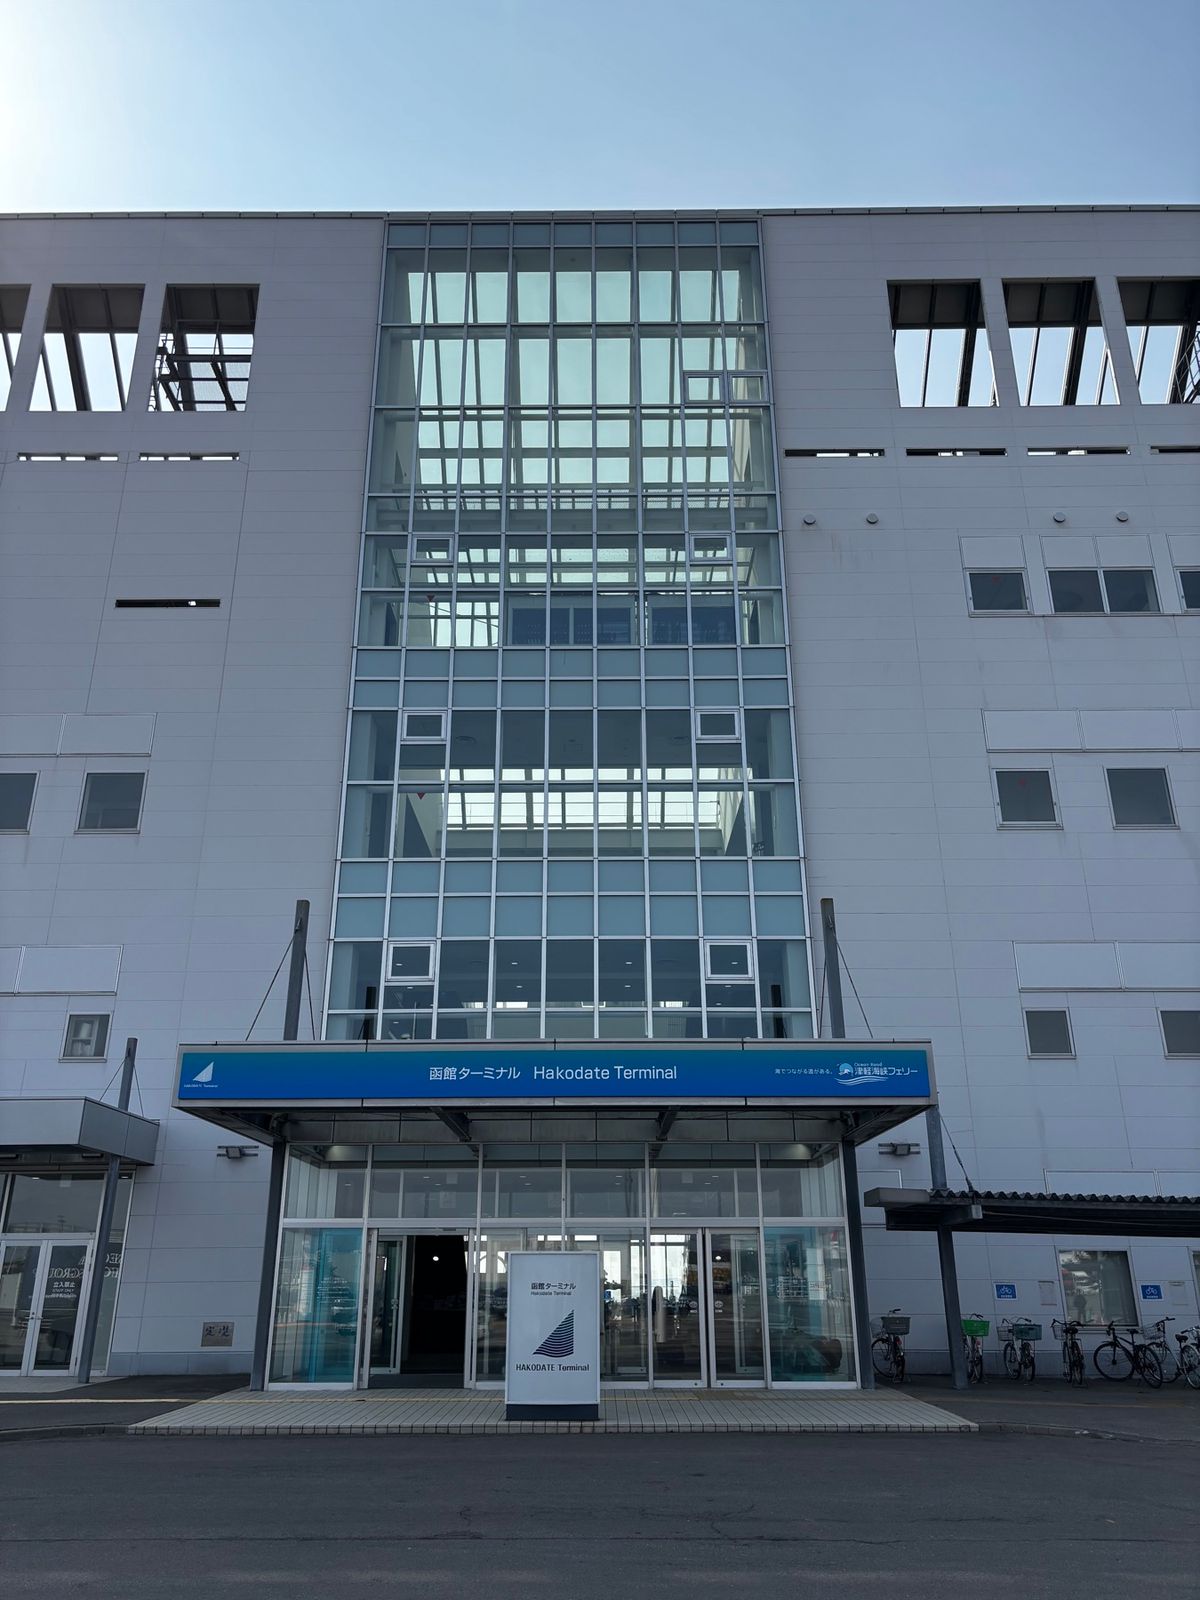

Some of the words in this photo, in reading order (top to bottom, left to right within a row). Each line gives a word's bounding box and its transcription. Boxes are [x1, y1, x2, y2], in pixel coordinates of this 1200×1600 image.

[429, 1066, 521, 1080] 函館ターミナル
[533, 1065, 610, 1080] Hakodate
[614, 1065, 677, 1080] Terminal
[854, 1067, 918, 1076] 津軽海峡フェリー
[531, 1282, 576, 1290] 函館ターミナル
